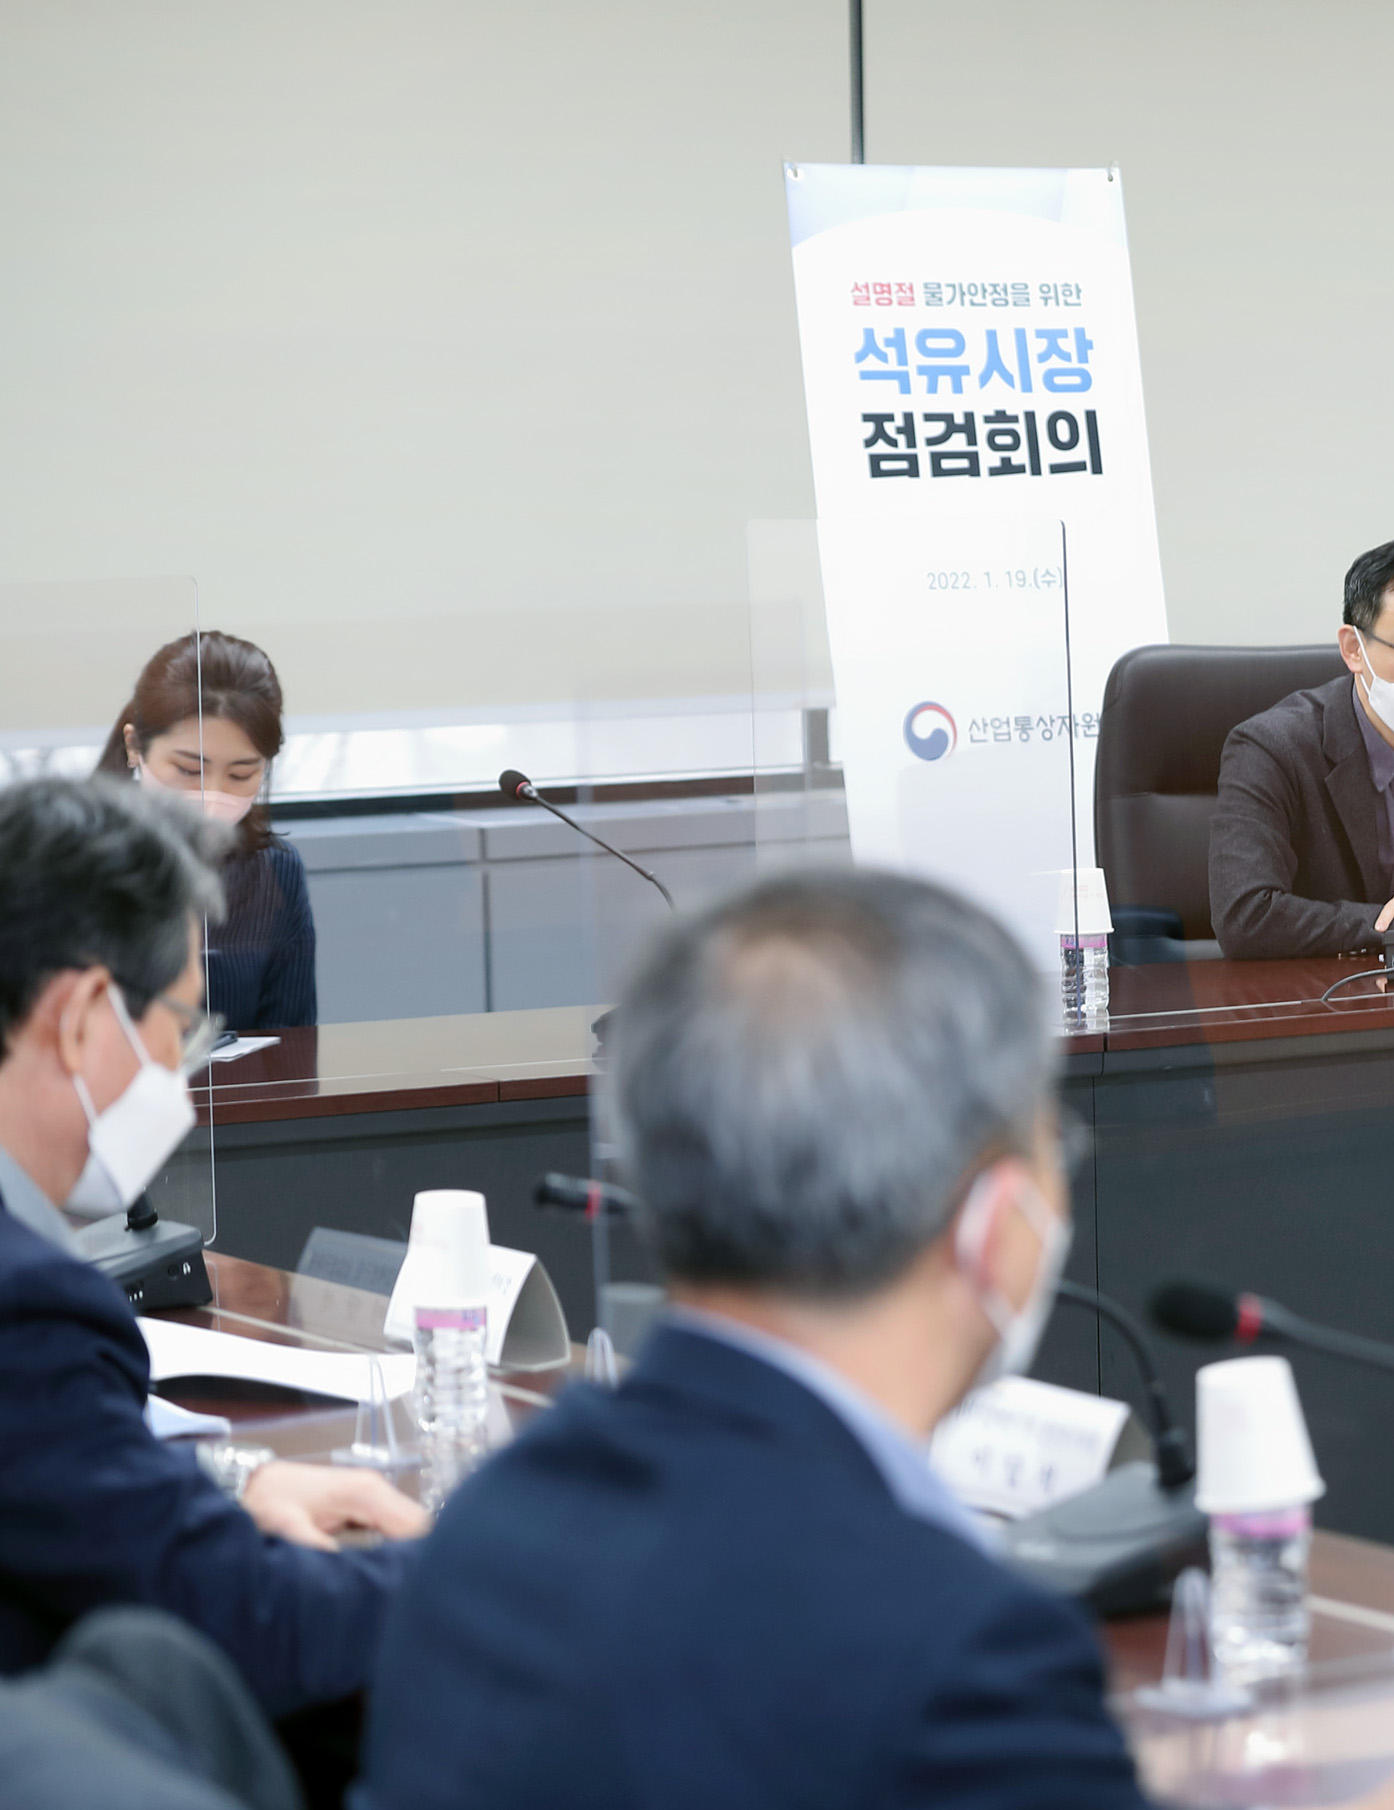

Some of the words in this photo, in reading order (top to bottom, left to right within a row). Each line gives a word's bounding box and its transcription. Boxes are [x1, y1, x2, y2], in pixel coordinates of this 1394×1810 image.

[851, 282, 915, 307] 설명절
[923, 282, 1031, 307] 물가안정을
[1039, 282, 1082, 307] 위한
[854, 327, 1094, 395] 석유시장
[861, 409, 1103, 479] 점검회의
[927, 571, 977, 590] 2022.
